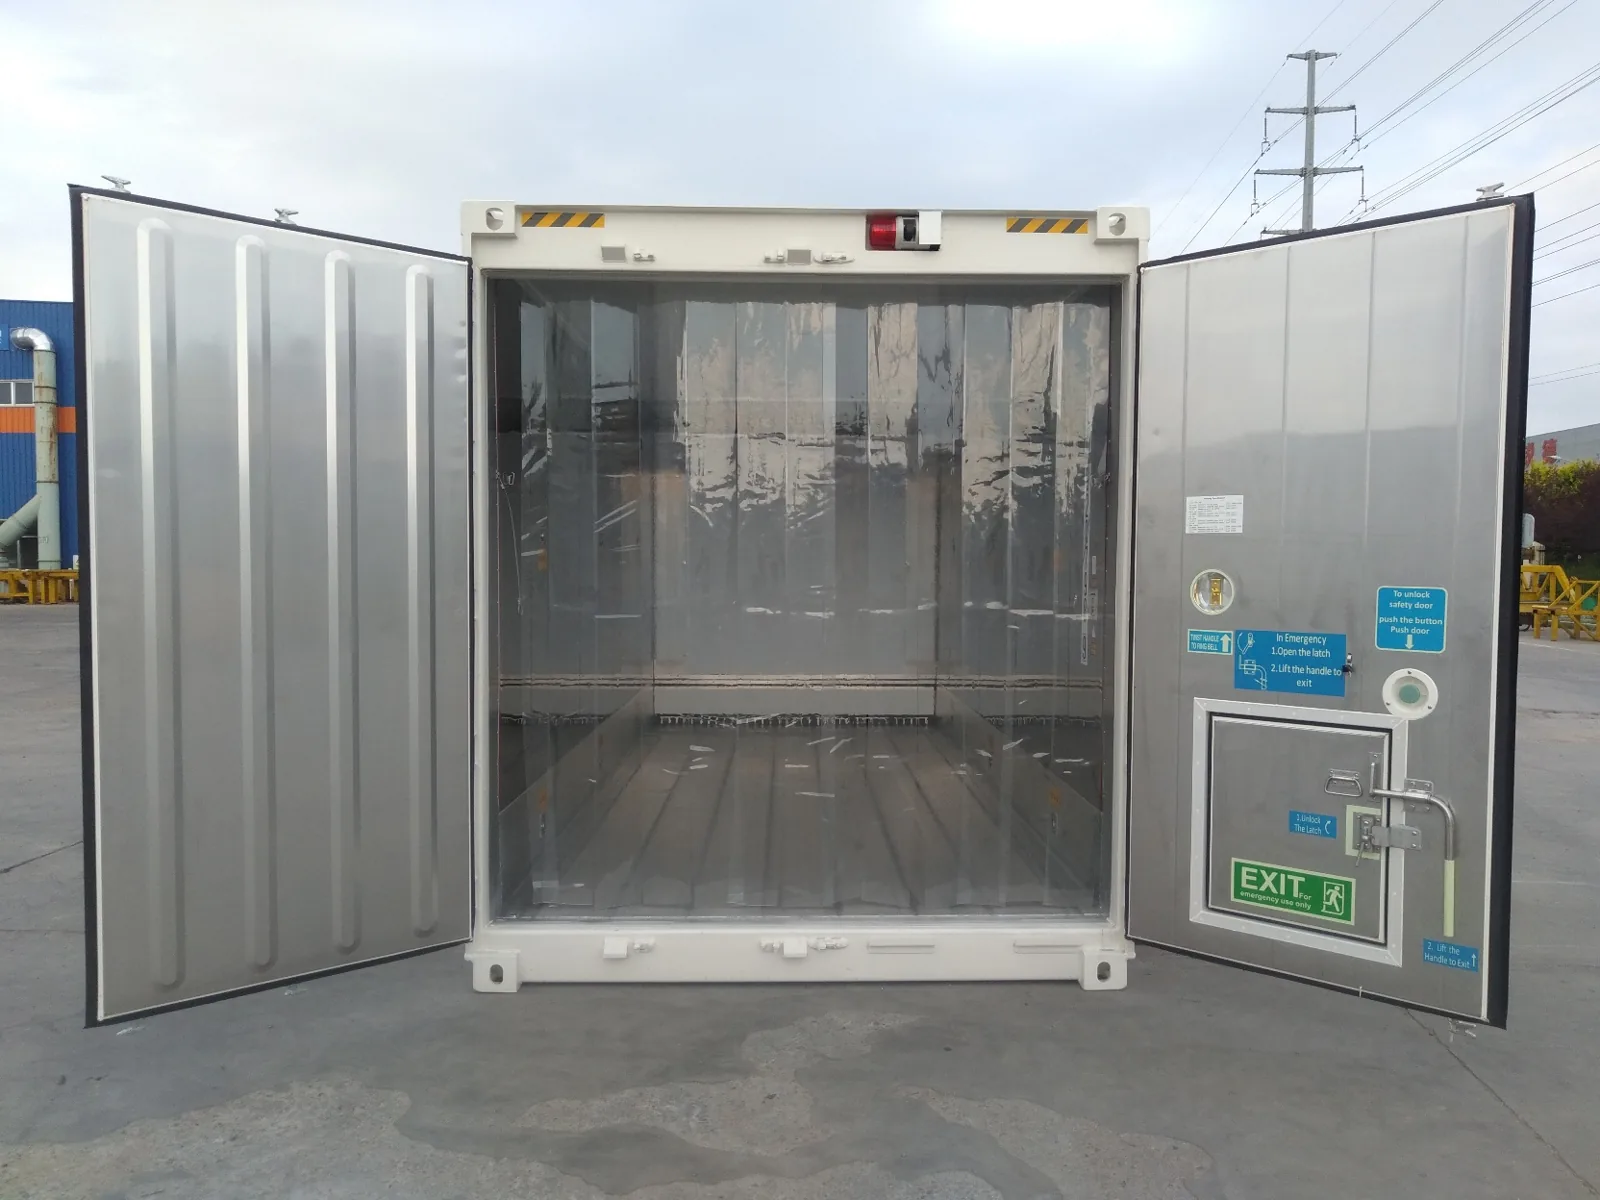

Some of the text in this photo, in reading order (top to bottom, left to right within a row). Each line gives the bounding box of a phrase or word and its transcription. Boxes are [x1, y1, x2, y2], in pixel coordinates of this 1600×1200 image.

[1389, 601, 1412, 609] safety
[1276, 633, 1326, 645] In Emergency
[1298, 648, 1310, 656] the
[1312, 648, 1331, 658] latch
[1279, 664, 1291, 673] Lift
[1292, 665, 1305, 674] the
[1306, 666, 1332, 676] handle
[1296, 679, 1312, 687] exit
[1294, 824, 1322, 835] The Latch
[1241, 866, 1312, 900] EXIT For
[1240, 891, 1279, 904] emergency
[1295, 901, 1312, 910] only
[1428, 942, 1460, 955] 2. Lift the
[1425, 953, 1447, 964] Handle
[1457, 959, 1470, 968] Exit
